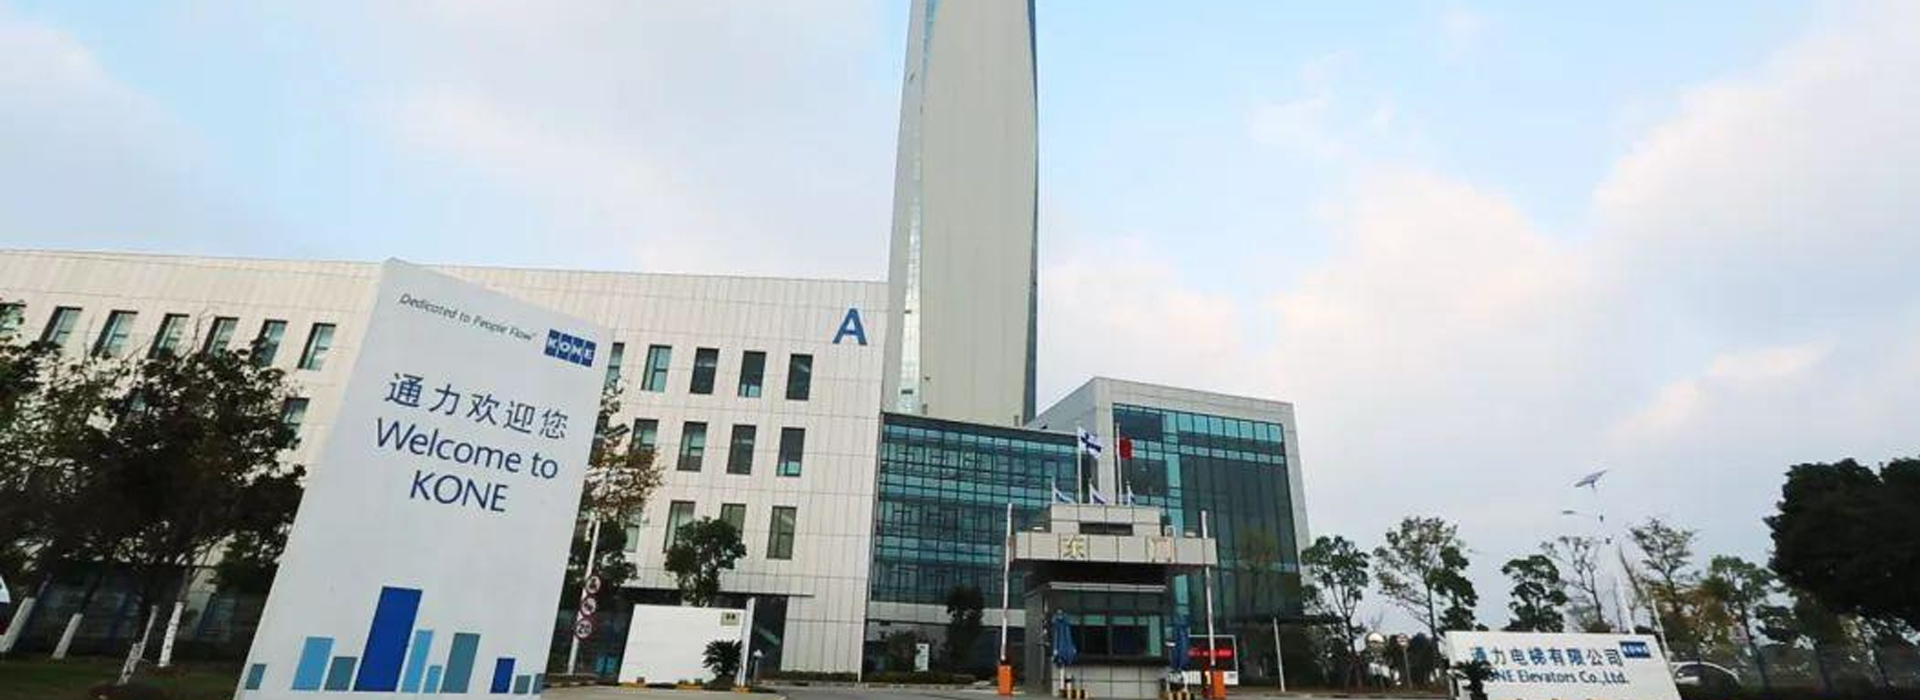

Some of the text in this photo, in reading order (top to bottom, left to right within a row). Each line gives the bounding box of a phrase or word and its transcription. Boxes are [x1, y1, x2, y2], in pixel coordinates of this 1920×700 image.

[400, 293, 458, 319] Dedicated
[459, 311, 471, 323] to
[473, 315, 508, 334] People
[832, 308, 868, 346] A
[546, 335, 595, 362] KONE
[385, 372, 569, 440] 通力欢迎您
[376, 416, 559, 480] Welcome to
[409, 469, 509, 513] KONE
[1517, 669, 1577, 683] Elevators
